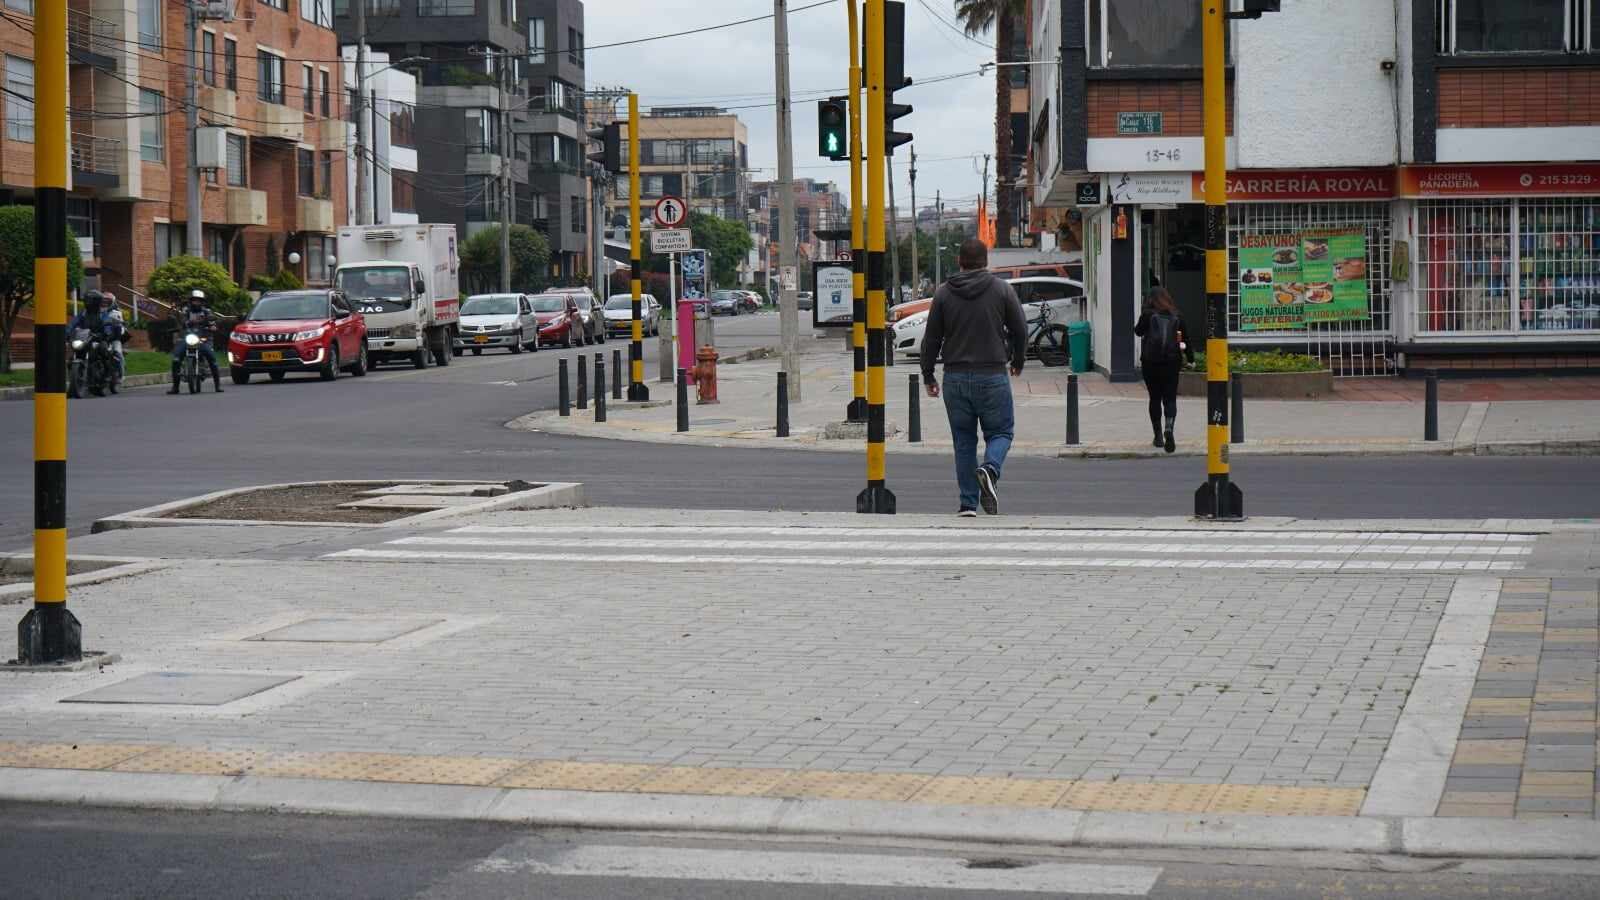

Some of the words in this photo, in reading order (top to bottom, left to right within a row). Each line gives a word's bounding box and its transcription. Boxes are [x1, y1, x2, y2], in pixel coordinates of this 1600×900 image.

[1200, 176, 1320, 193] GARRERÍA
[1325, 178, 1389, 192] ROYAL
[1539, 176, 1559, 185] 215
[1562, 175, 1591, 185] 3229
